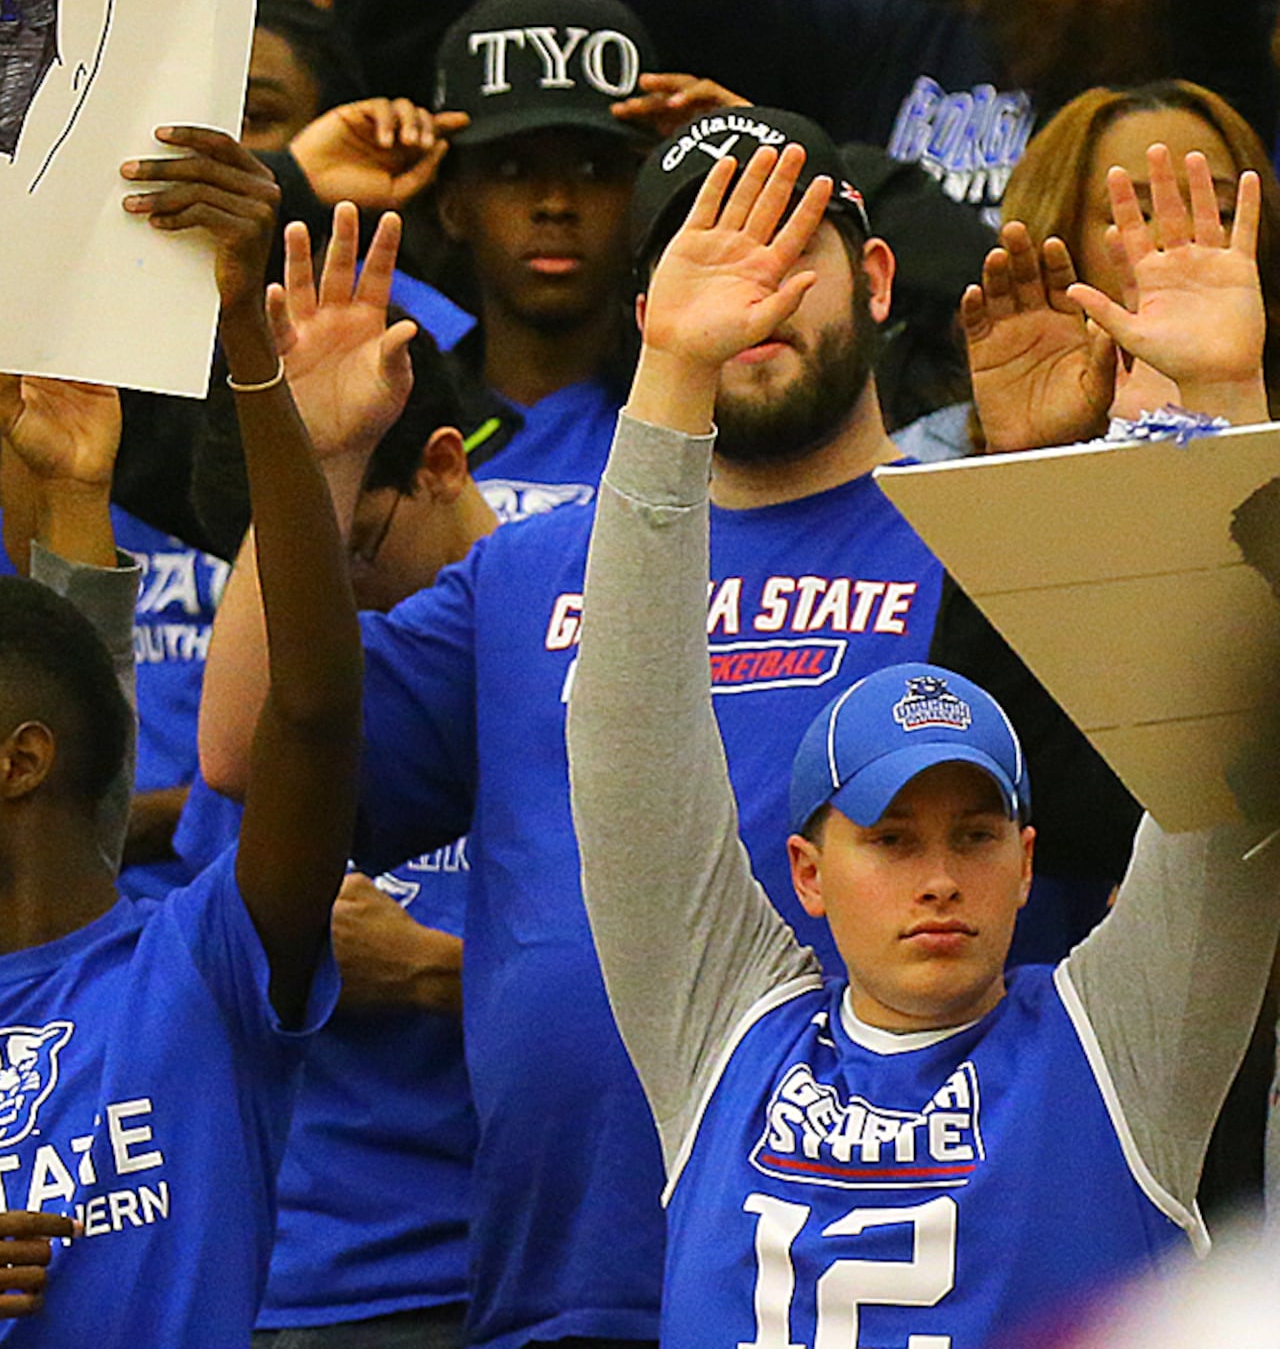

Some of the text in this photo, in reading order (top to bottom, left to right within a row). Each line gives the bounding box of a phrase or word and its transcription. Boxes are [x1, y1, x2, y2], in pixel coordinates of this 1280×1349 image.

[469, 27, 639, 97] TYO
[661, 114, 787, 173] Callaway
[753, 577, 918, 635] STATE
[737, 1192, 958, 1349] 12
